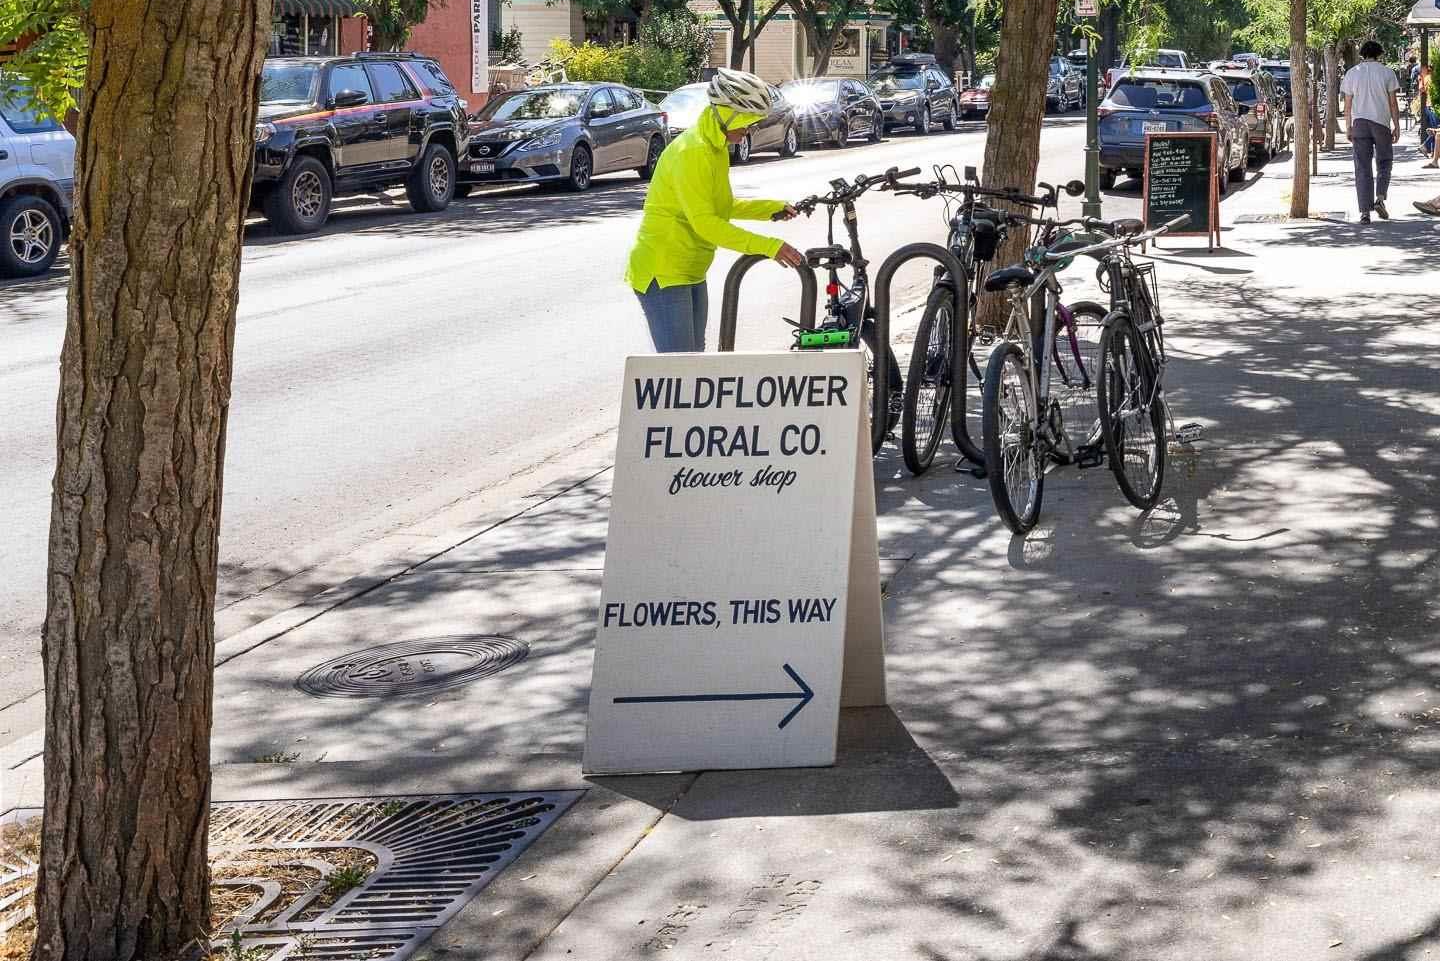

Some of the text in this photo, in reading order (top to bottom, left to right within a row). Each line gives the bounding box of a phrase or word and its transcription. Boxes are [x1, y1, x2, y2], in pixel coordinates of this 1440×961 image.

[634, 375, 848, 410] WILDFLOWER
[644, 423, 827, 458] FLORAL CO.
[668, 464, 797, 496] flower shop
[603, 597, 838, 630] FLOWERS, THIS WAY
